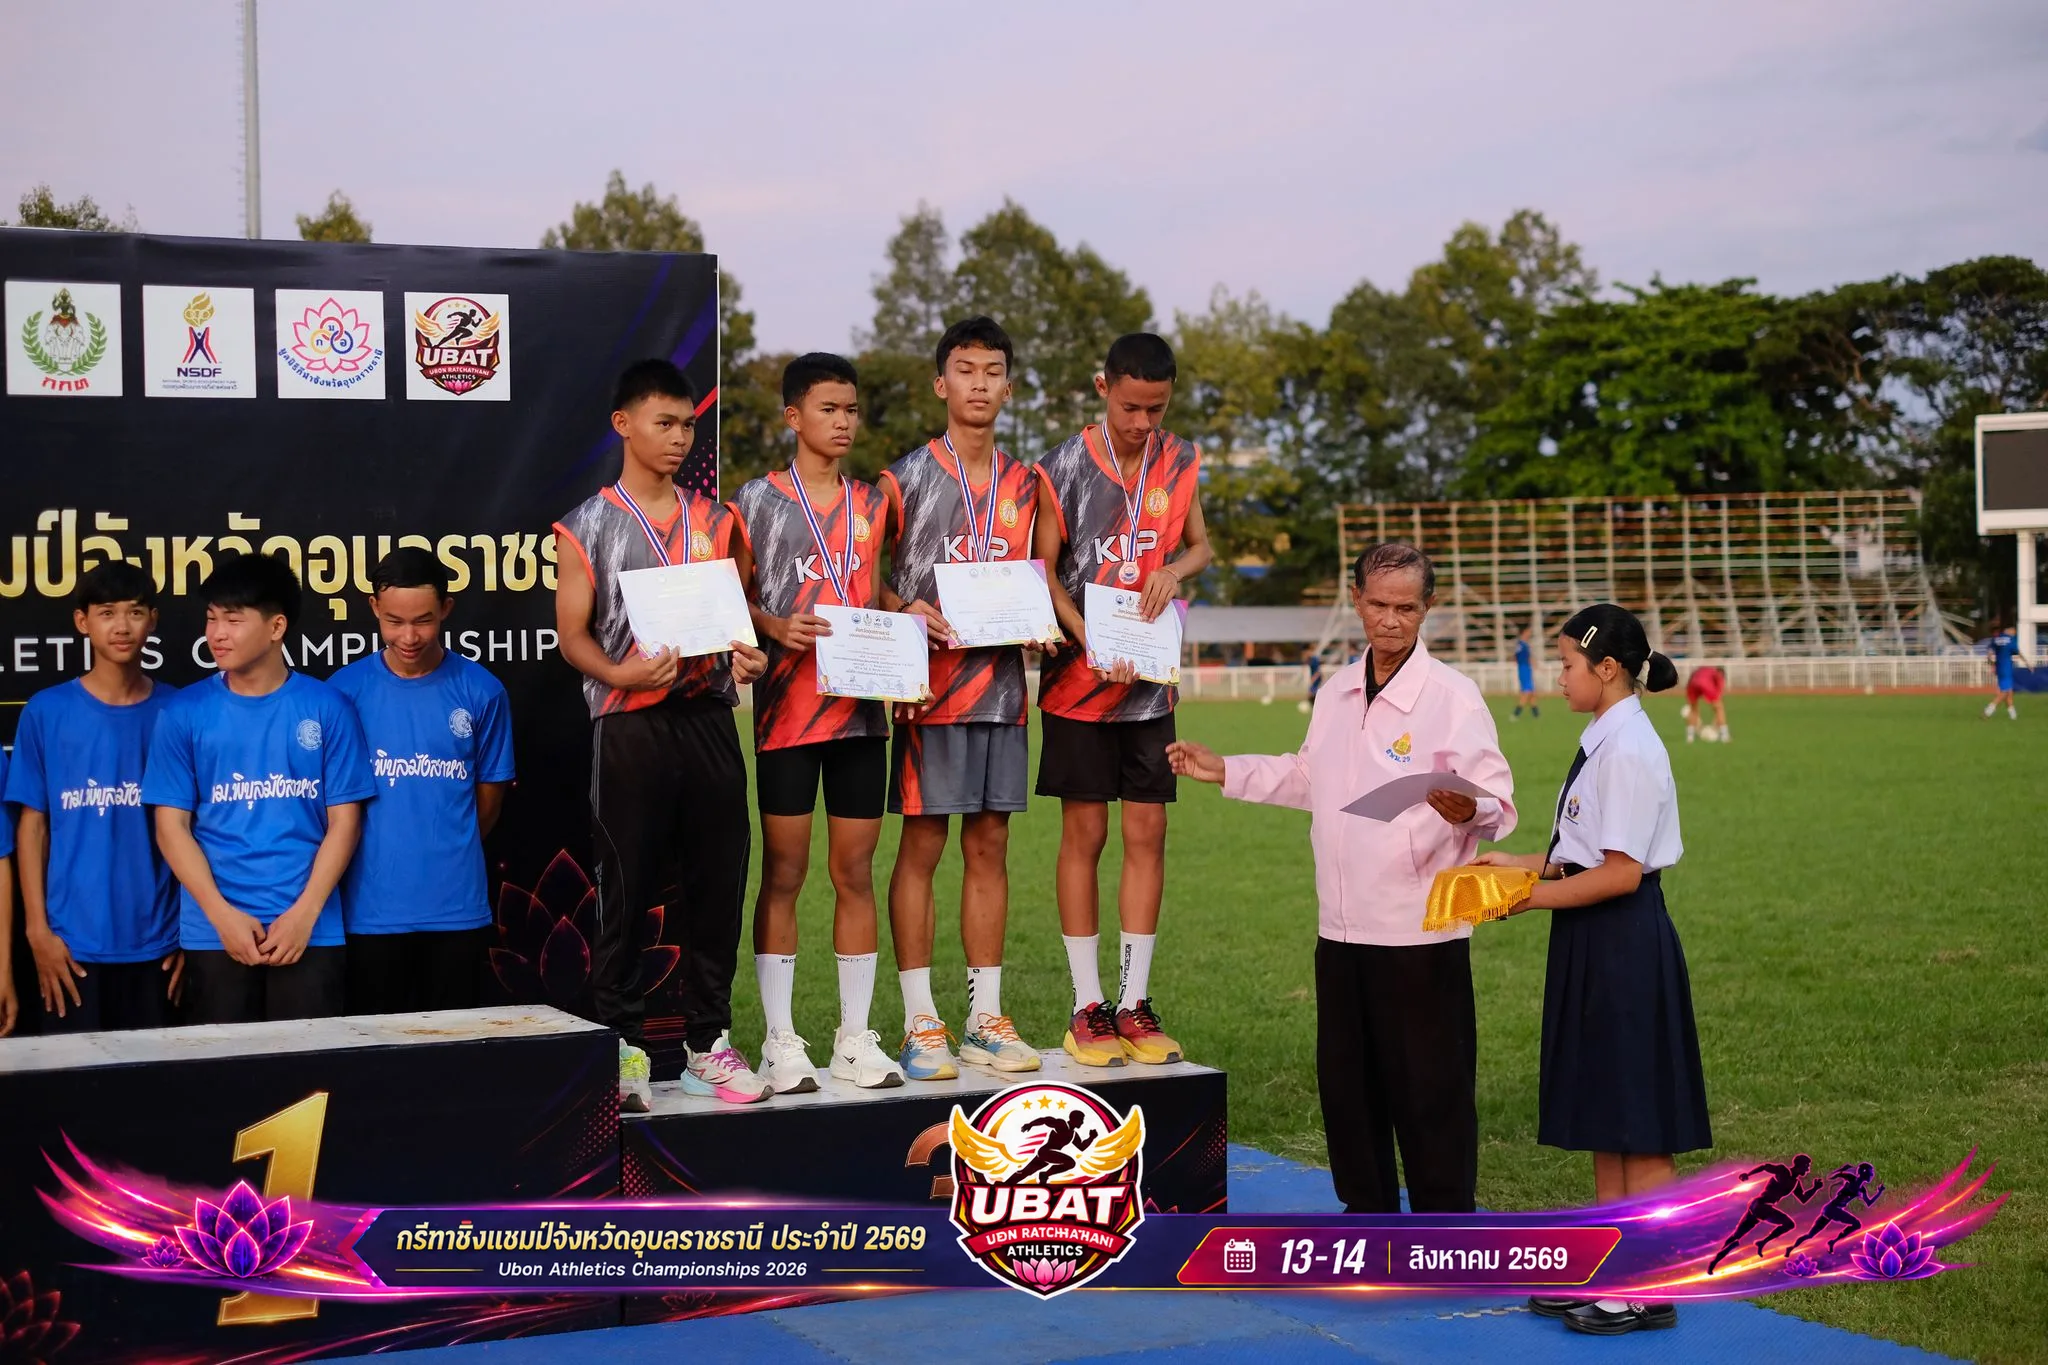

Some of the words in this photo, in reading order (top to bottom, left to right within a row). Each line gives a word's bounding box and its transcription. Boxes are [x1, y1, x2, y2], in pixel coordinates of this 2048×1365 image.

[422, 347, 494, 367] UBAT
[177, 367, 222, 378] NSDF
[42, 376, 89, 392] กกท
[218, 1091, 329, 1326] 1
